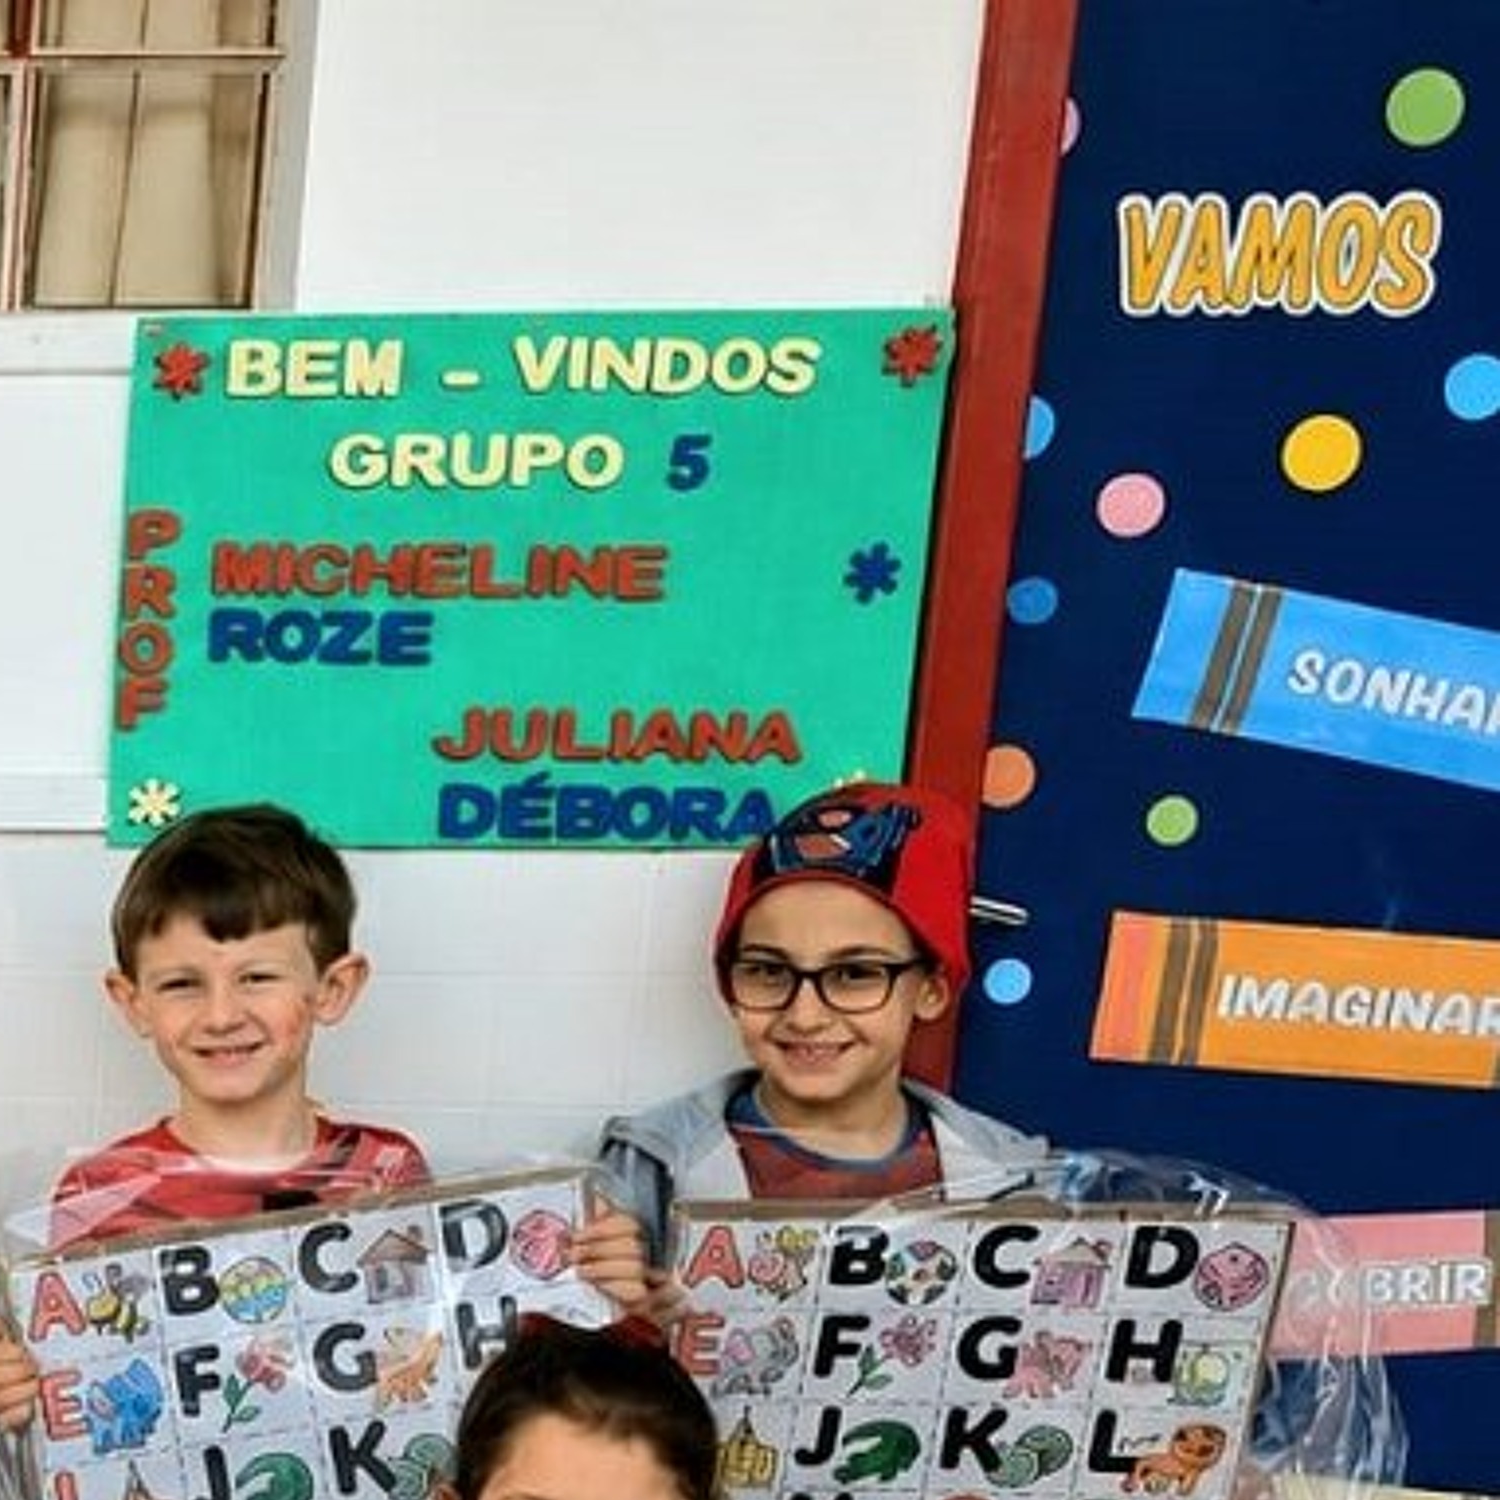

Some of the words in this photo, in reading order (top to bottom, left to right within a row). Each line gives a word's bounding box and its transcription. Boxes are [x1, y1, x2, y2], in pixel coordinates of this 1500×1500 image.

[1121, 195, 1439, 314] VAMOS
[225, 340, 402, 398] BEM
[512, 338, 822, 394] VINDOS
[330, 432, 623, 488] GRUPO
[666, 434, 712, 489] 5
[212, 541, 668, 599] MICHELINE
[116, 512, 181, 730] PROF
[208, 611, 433, 666] ROZE
[434, 709, 802, 763] JULIANA
[438, 772, 781, 841] DÉBORA
[32, 1272, 85, 1343] A
[161, 1244, 220, 1317] B
[299, 1223, 360, 1294] C
[439, 1200, 508, 1271] D
[682, 1226, 745, 1289] A
[828, 1226, 888, 1287] B
[973, 1225, 1039, 1287] C
[1125, 1225, 1199, 1289] D
[40, 1370, 86, 1441] E
[175, 1344, 220, 1416] F
[313, 1323, 376, 1392] G
[457, 1296, 517, 1370] H
[677, 1315, 724, 1375] E
[814, 1315, 870, 1378] F
[957, 1318, 1023, 1379] G
[1105, 1319, 1183, 1383] H
[329, 1420, 397, 1494] K
[794, 1408, 842, 1467] J
[940, 1407, 1008, 1471] K
[1087, 1410, 1138, 1475] L
